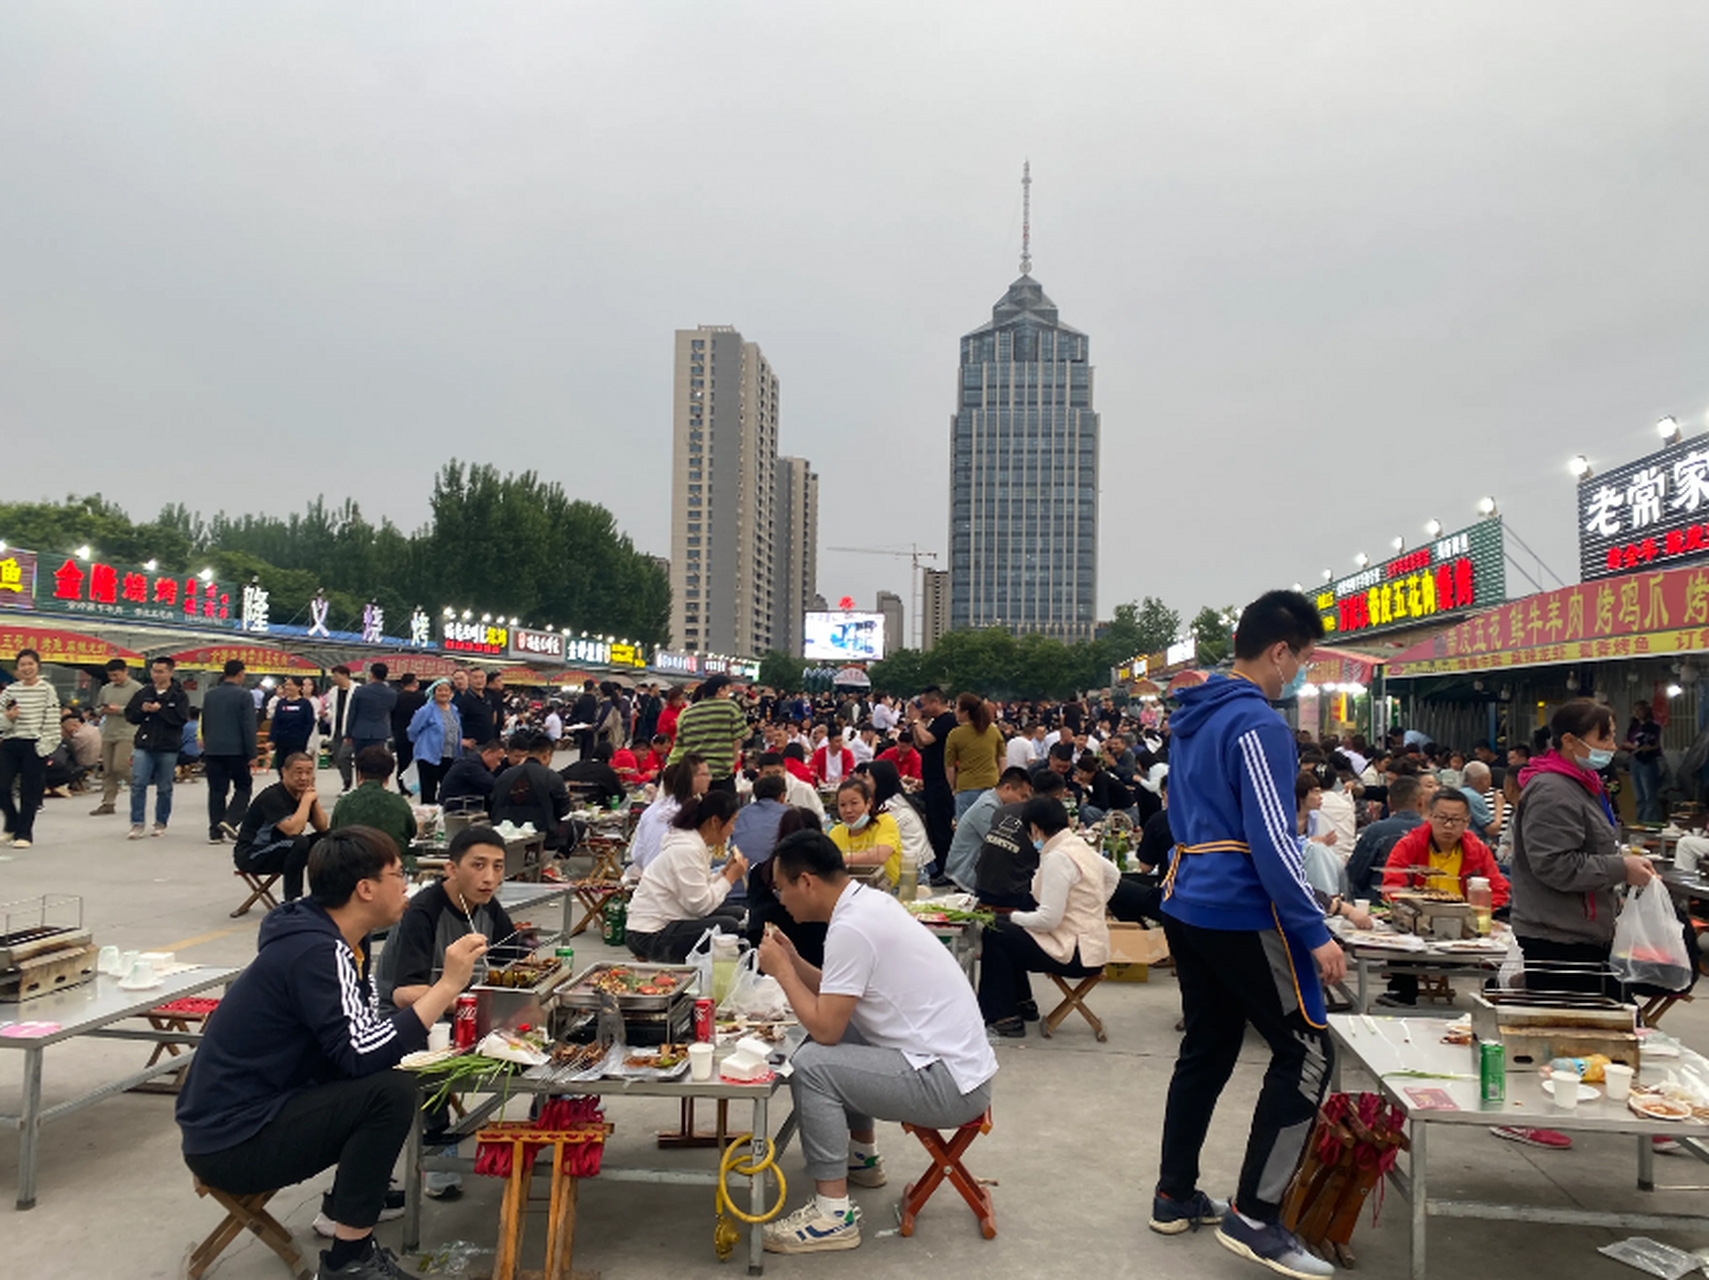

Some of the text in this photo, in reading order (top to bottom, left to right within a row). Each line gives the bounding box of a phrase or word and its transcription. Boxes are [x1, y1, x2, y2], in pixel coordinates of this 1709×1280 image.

[1586, 451, 1709, 537] 老常家
[54, 559, 178, 605] 金隆烧烤
[1509, 588, 1583, 647] 鲜牛羊肉
[1594, 572, 1669, 634] 烤鸡爪
